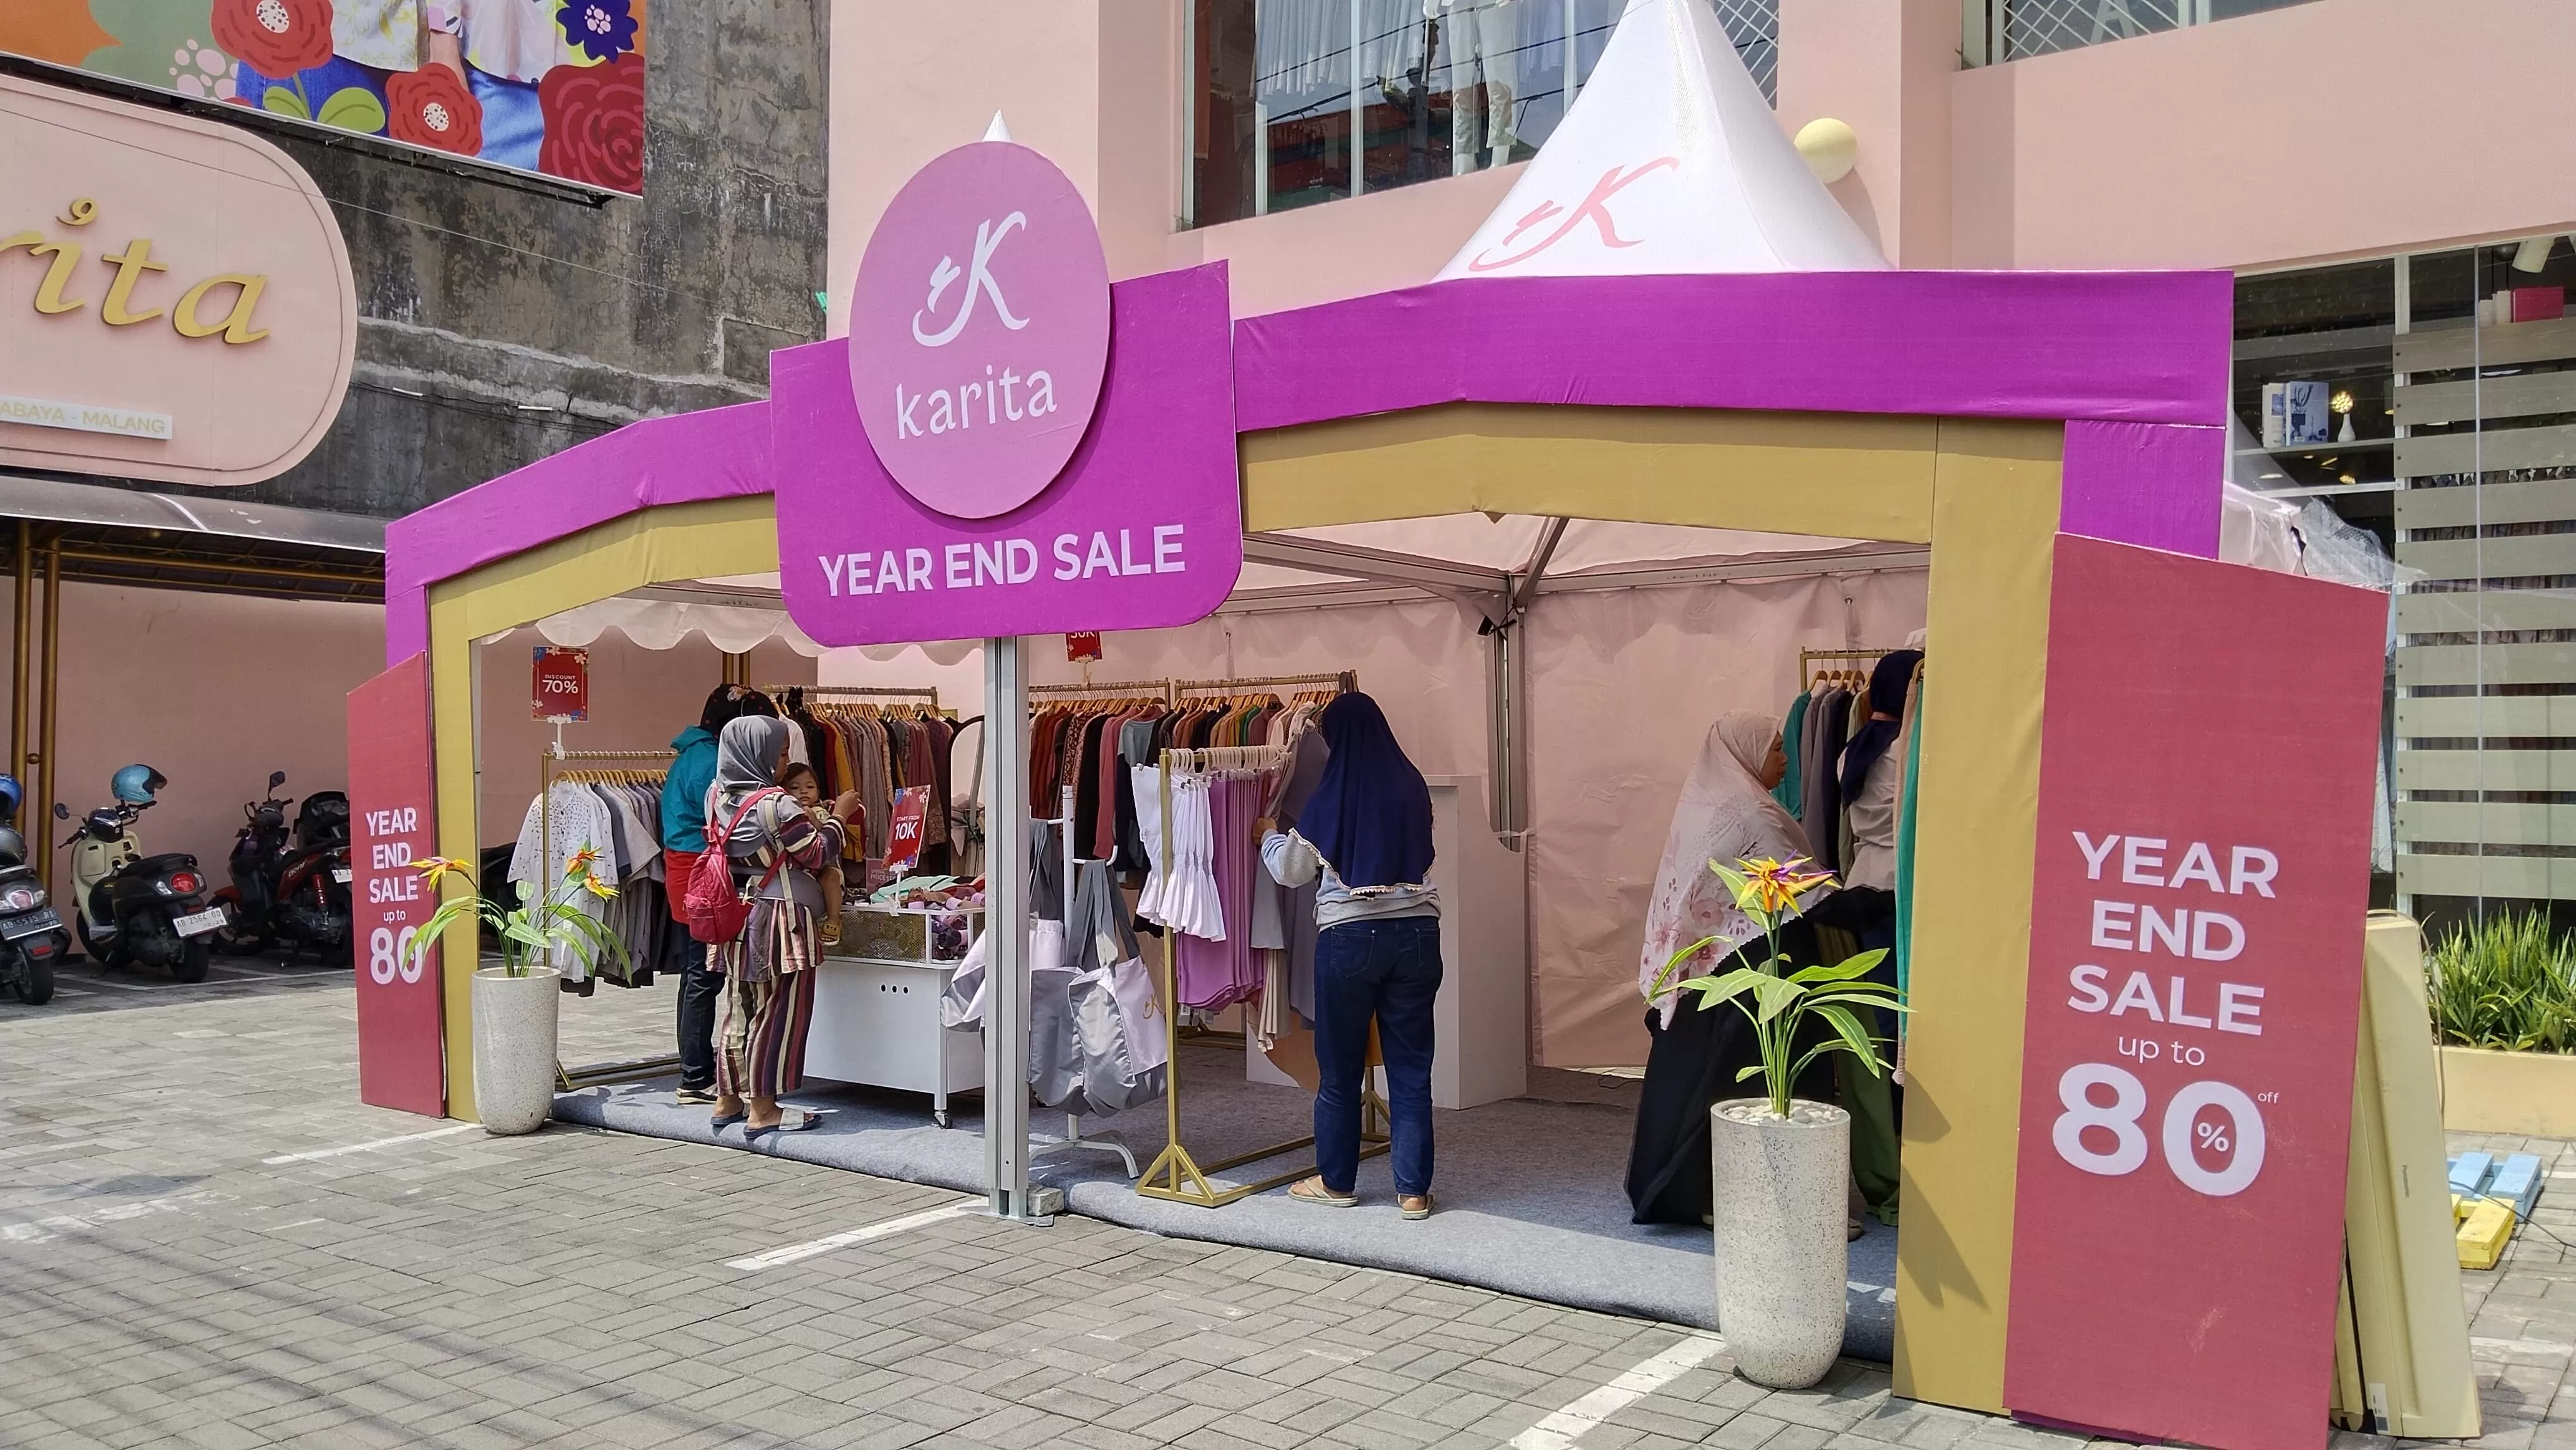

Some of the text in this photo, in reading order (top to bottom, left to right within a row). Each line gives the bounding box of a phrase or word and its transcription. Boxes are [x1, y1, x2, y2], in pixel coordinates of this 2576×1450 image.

[896, 364, 1058, 440] karita
[83, 410, 165, 434] MALANG
[818, 524, 1186, 597] YEAR END SALE
[542, 680, 578, 693] 70%
[366, 807, 417, 836] YEAR
[895, 822, 918, 840] 10K
[373, 842, 412, 870] END
[2072, 830, 2279, 899] YEAR
[369, 875, 419, 904] SALE
[2, 921, 14, 930] AB
[177, 920, 186, 928] AB
[383, 909, 406, 924] up to
[2090, 899, 2246, 962] END
[371, 926, 423, 985] 80
[2067, 964, 2265, 1036] SALE
[2118, 1036, 2205, 1066] up to
[2257, 1091, 2279, 1104] off
